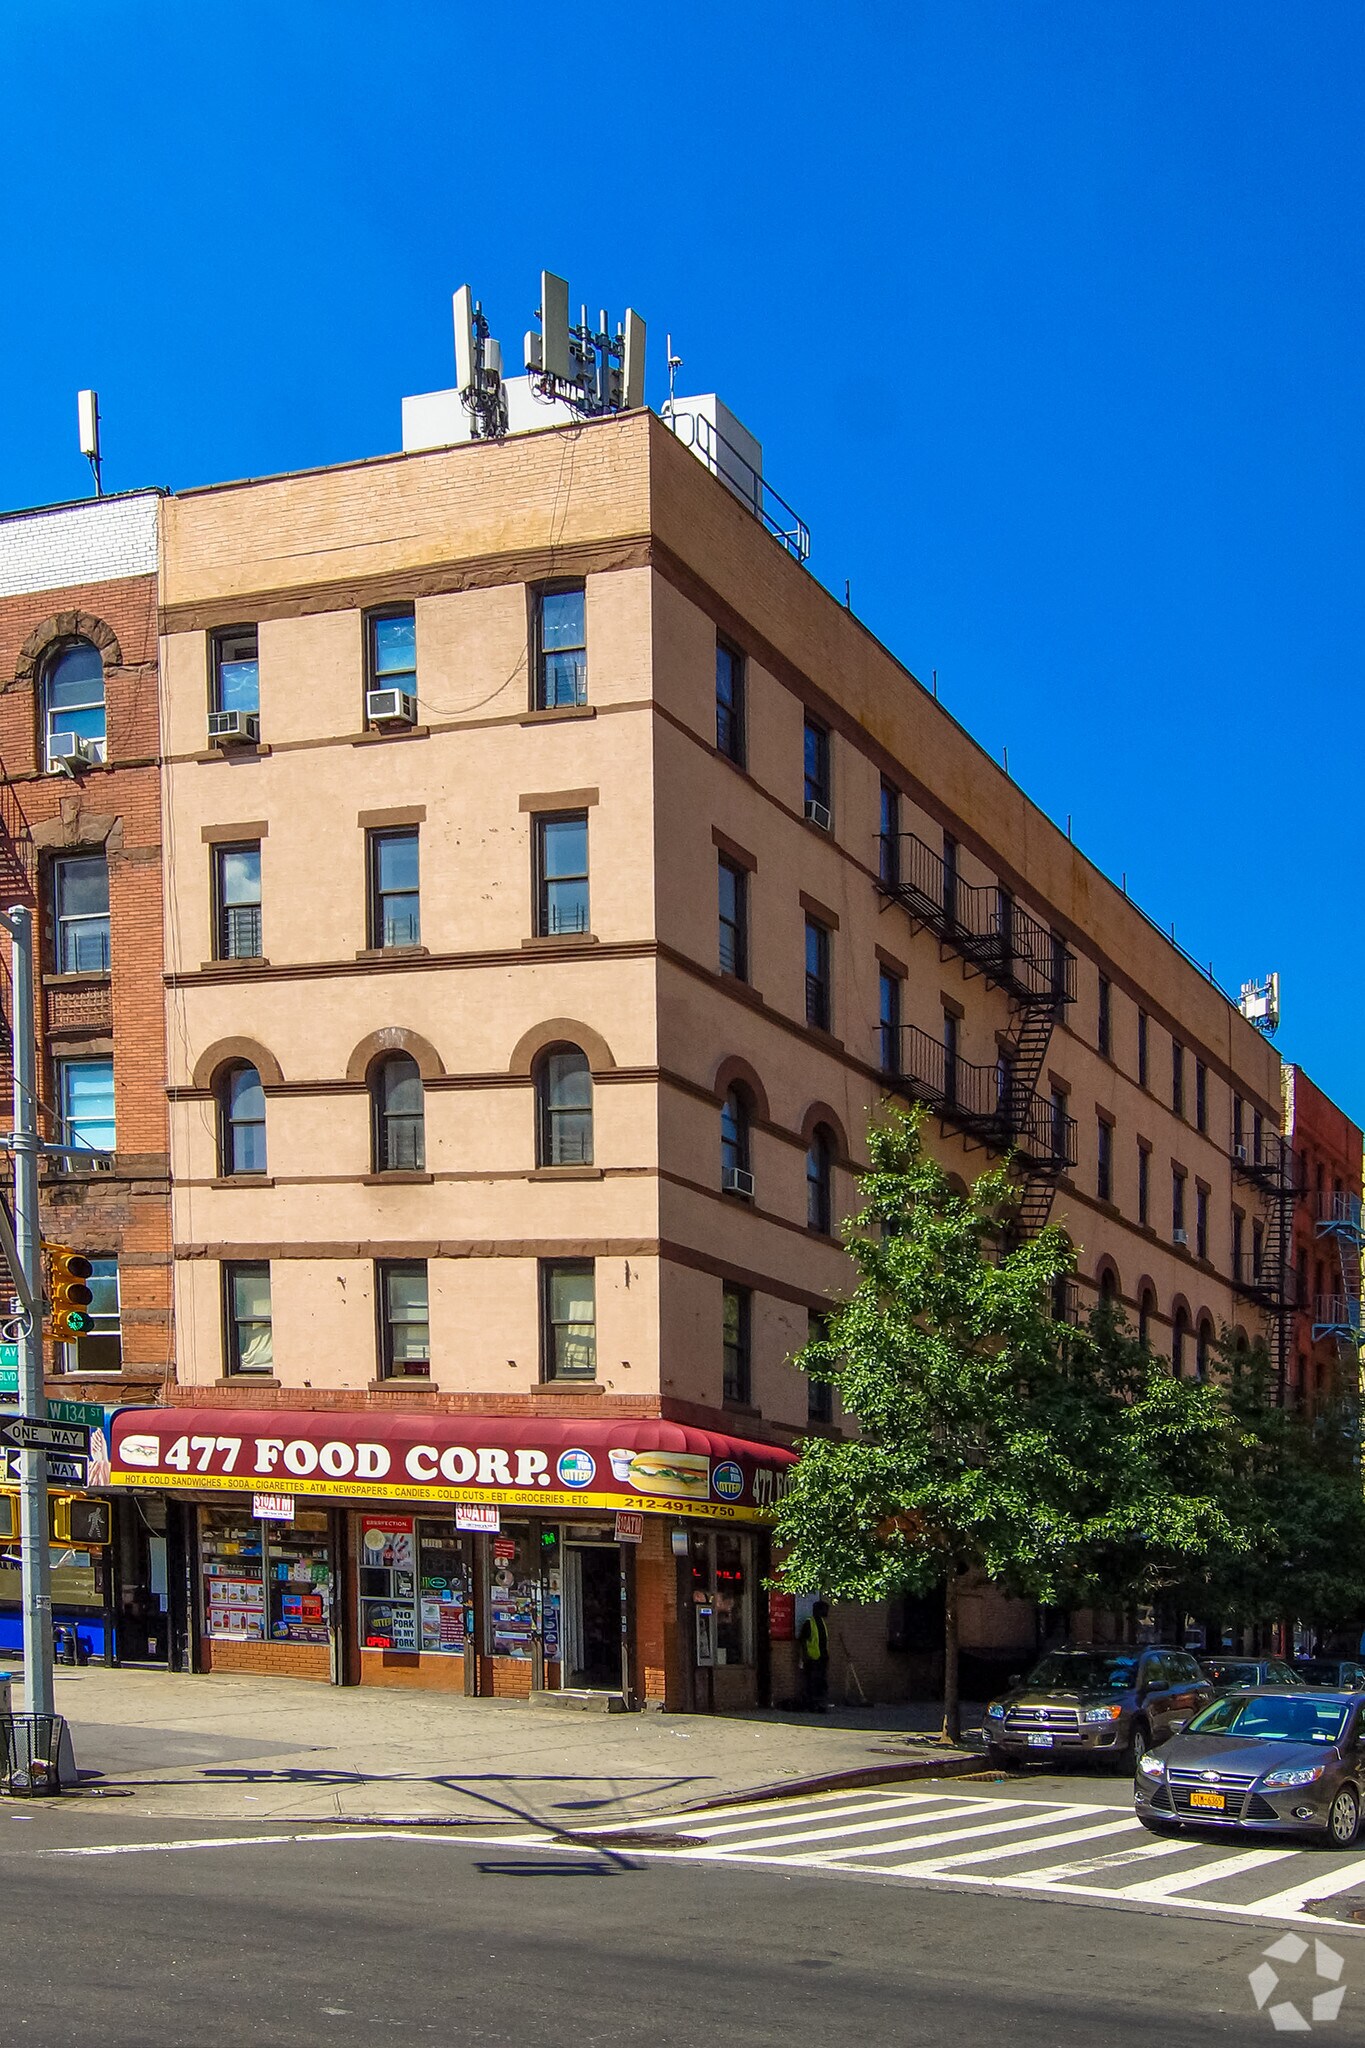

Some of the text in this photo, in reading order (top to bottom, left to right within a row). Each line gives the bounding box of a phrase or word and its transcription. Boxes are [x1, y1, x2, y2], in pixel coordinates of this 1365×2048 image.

[5, 1347, 17, 1356] AV
[49, 1402, 101, 1423] W 134 ST
[12, 1425, 79, 1445] ONE WAY
[51, 1462, 77, 1476] WAY
[164, 1435, 551, 1487] 477 FOOD CORP.
[125, 1474, 140, 1483] HOT
[149, 1475, 170, 1485] COLD
[171, 1476, 222, 1487] SANDWICHES
[227, 1479, 249, 1488] SODA
[255, 1480, 305, 1491] CIGARETTES
[310, 1483, 327, 1492] ATM
[333, 1485, 388, 1496] NEWSPAPERS
[394, 1487, 431, 1497] CANDIES
[437, 1489, 460, 1499] COLD
[462, 1491, 485, 1500] CUTS
[491, 1492, 508, 1501] EBT
[514, 1493, 565, 1504] GROCERIES
[571, 1495, 589, 1504] ETC
[752, 1468, 773, 1504] 477
[624, 1497, 735, 1517] 212-491-3750
[393, 1619, 415, 1628] PORK
[395, 1611, 411, 1619] NO
[366, 1636, 391, 1648] OPEN
[395, 1639, 415, 1648] FORK
